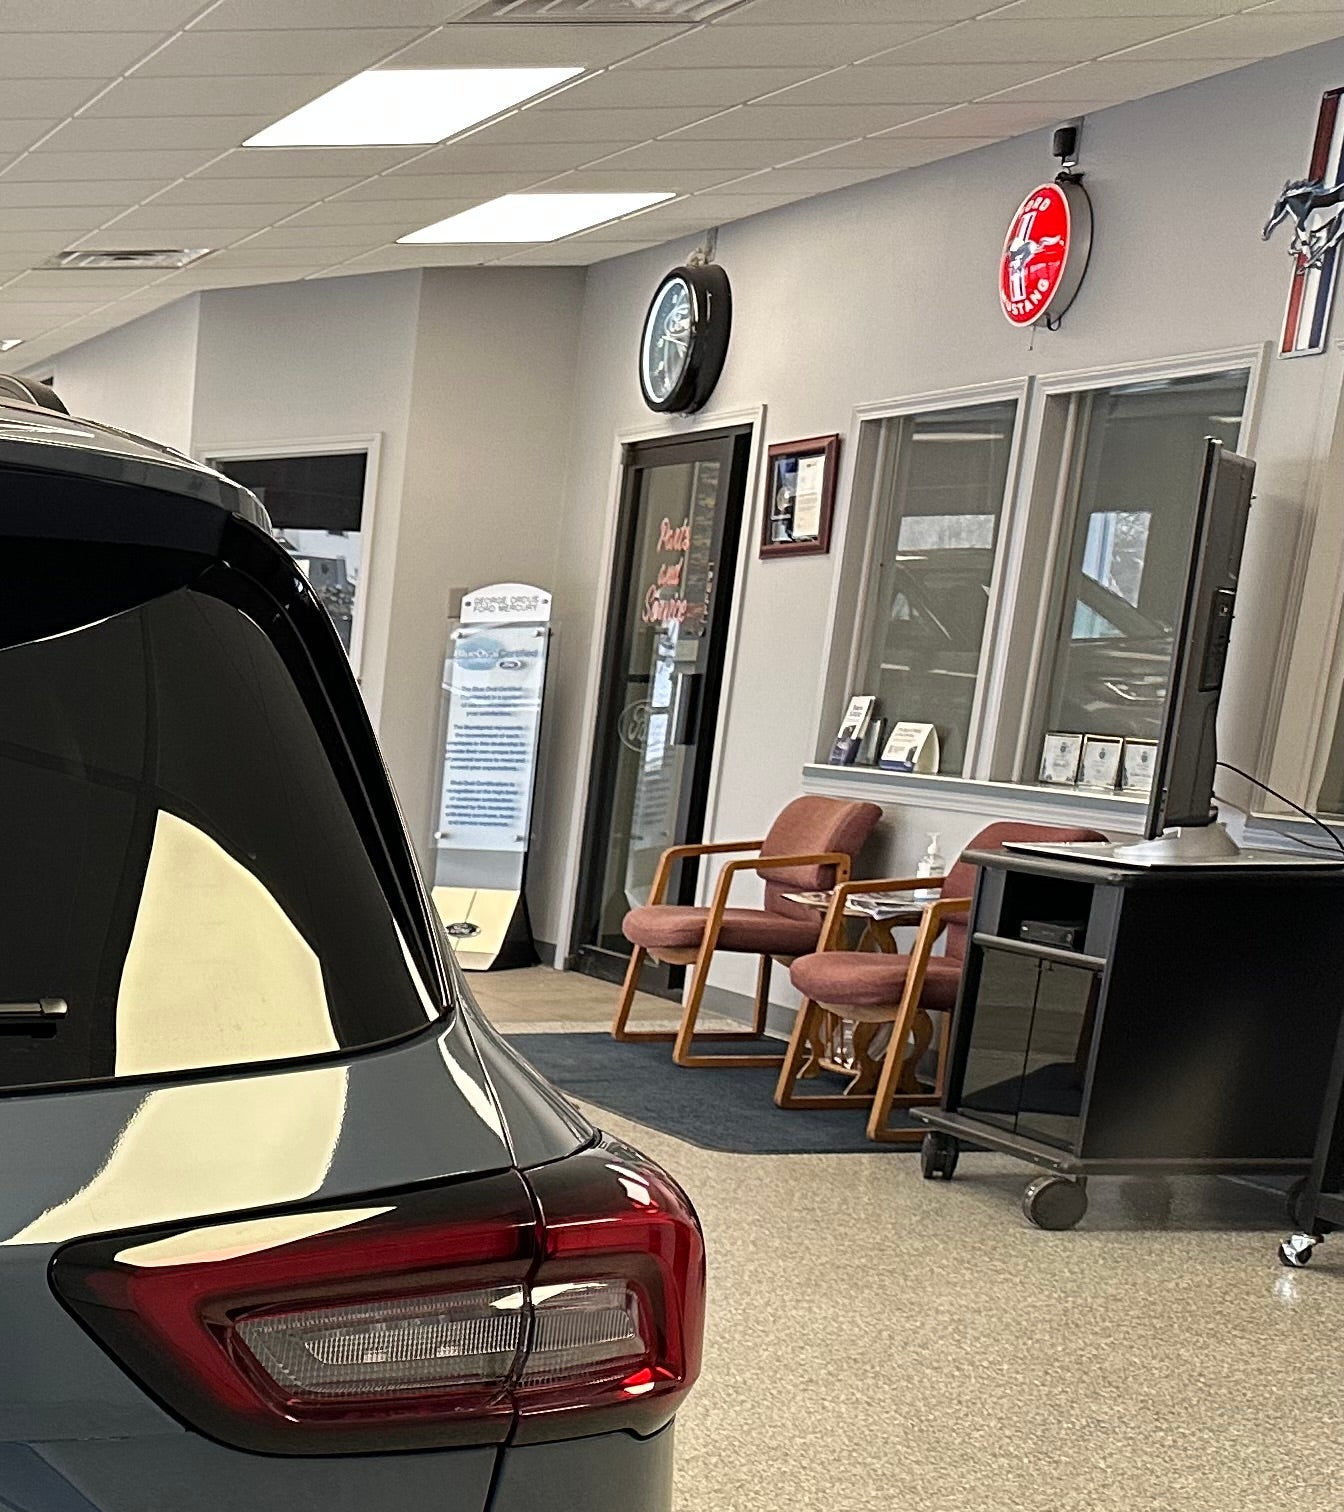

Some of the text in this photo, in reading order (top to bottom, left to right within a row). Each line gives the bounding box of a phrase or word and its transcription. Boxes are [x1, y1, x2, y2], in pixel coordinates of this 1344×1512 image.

[657, 517, 691, 552] Parts
[657, 556, 684, 586] and
[641, 584, 688, 623] Service
